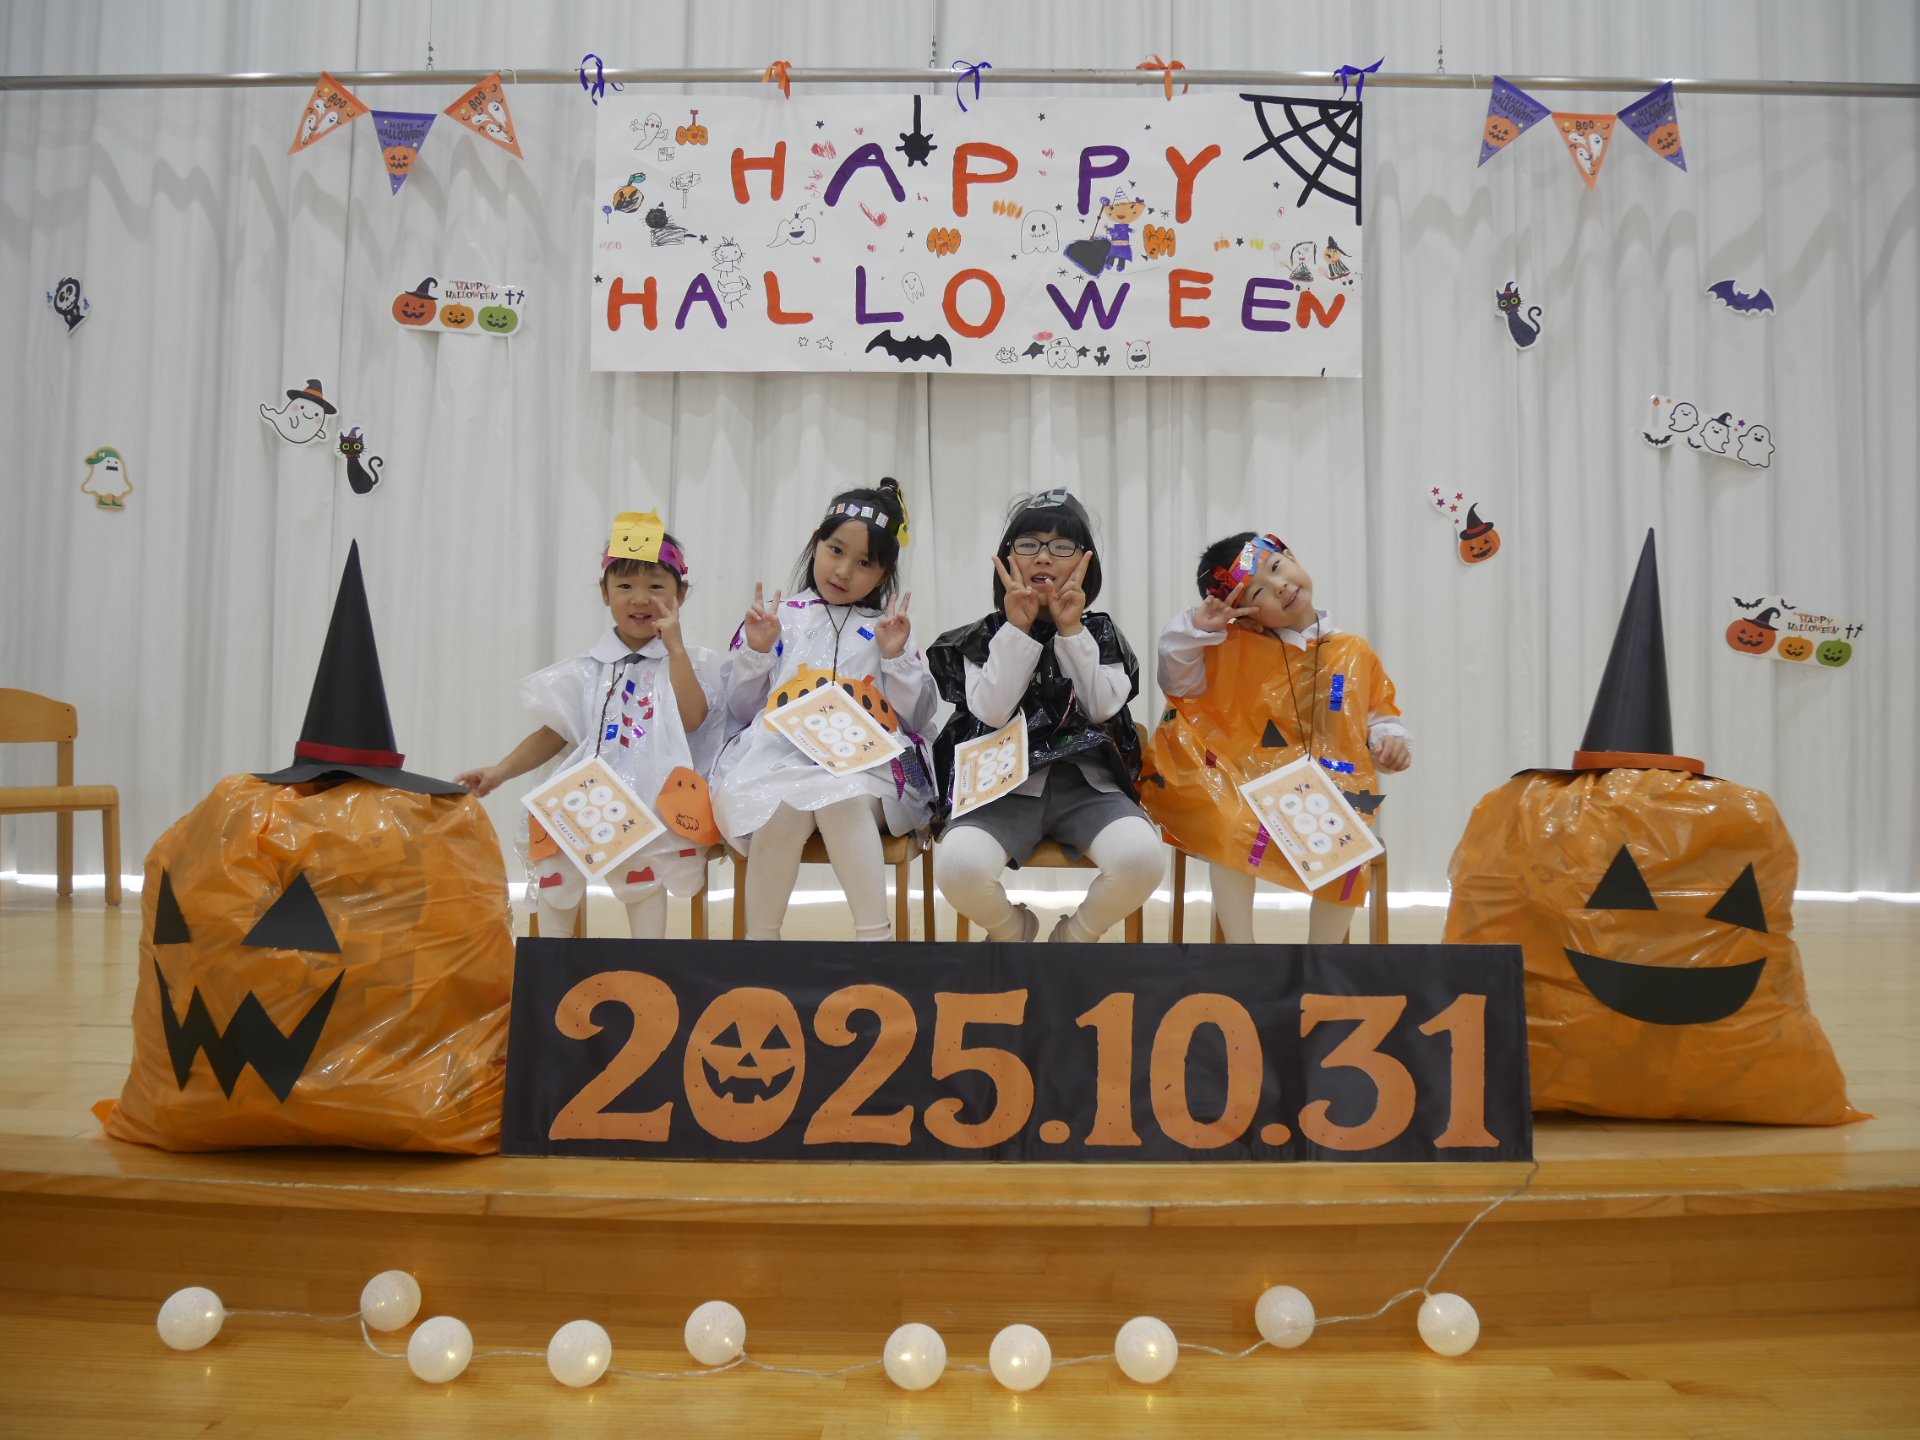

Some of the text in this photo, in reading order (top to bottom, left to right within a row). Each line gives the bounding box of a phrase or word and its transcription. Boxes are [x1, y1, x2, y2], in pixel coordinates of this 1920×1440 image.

[328, 92, 348, 110] BOO
[467, 90, 487, 111] BOO
[1491, 93, 1536, 123] HALLOWEEN
[1505, 94, 1529, 110] HAPPY
[1632, 102, 1674, 129] HALLOWEEN
[1638, 102, 1662, 117] HAPPY
[389, 121, 414, 129] HAPPY
[1575, 120, 1595, 131] BOO
[377, 128, 425, 141] HALLOWEEN
[731, 141, 1221, 224] HAPPY
[455, 281, 490, 292] HAPPY
[445, 290, 499, 301] HALLOWEEN
[607, 265, 1345, 339] HALLOWEEN
[1798, 613, 1834, 625] HAPPY
[1787, 622, 1839, 634] HALLOWEEN
[547, 970, 1500, 1152] 2025.10.31
